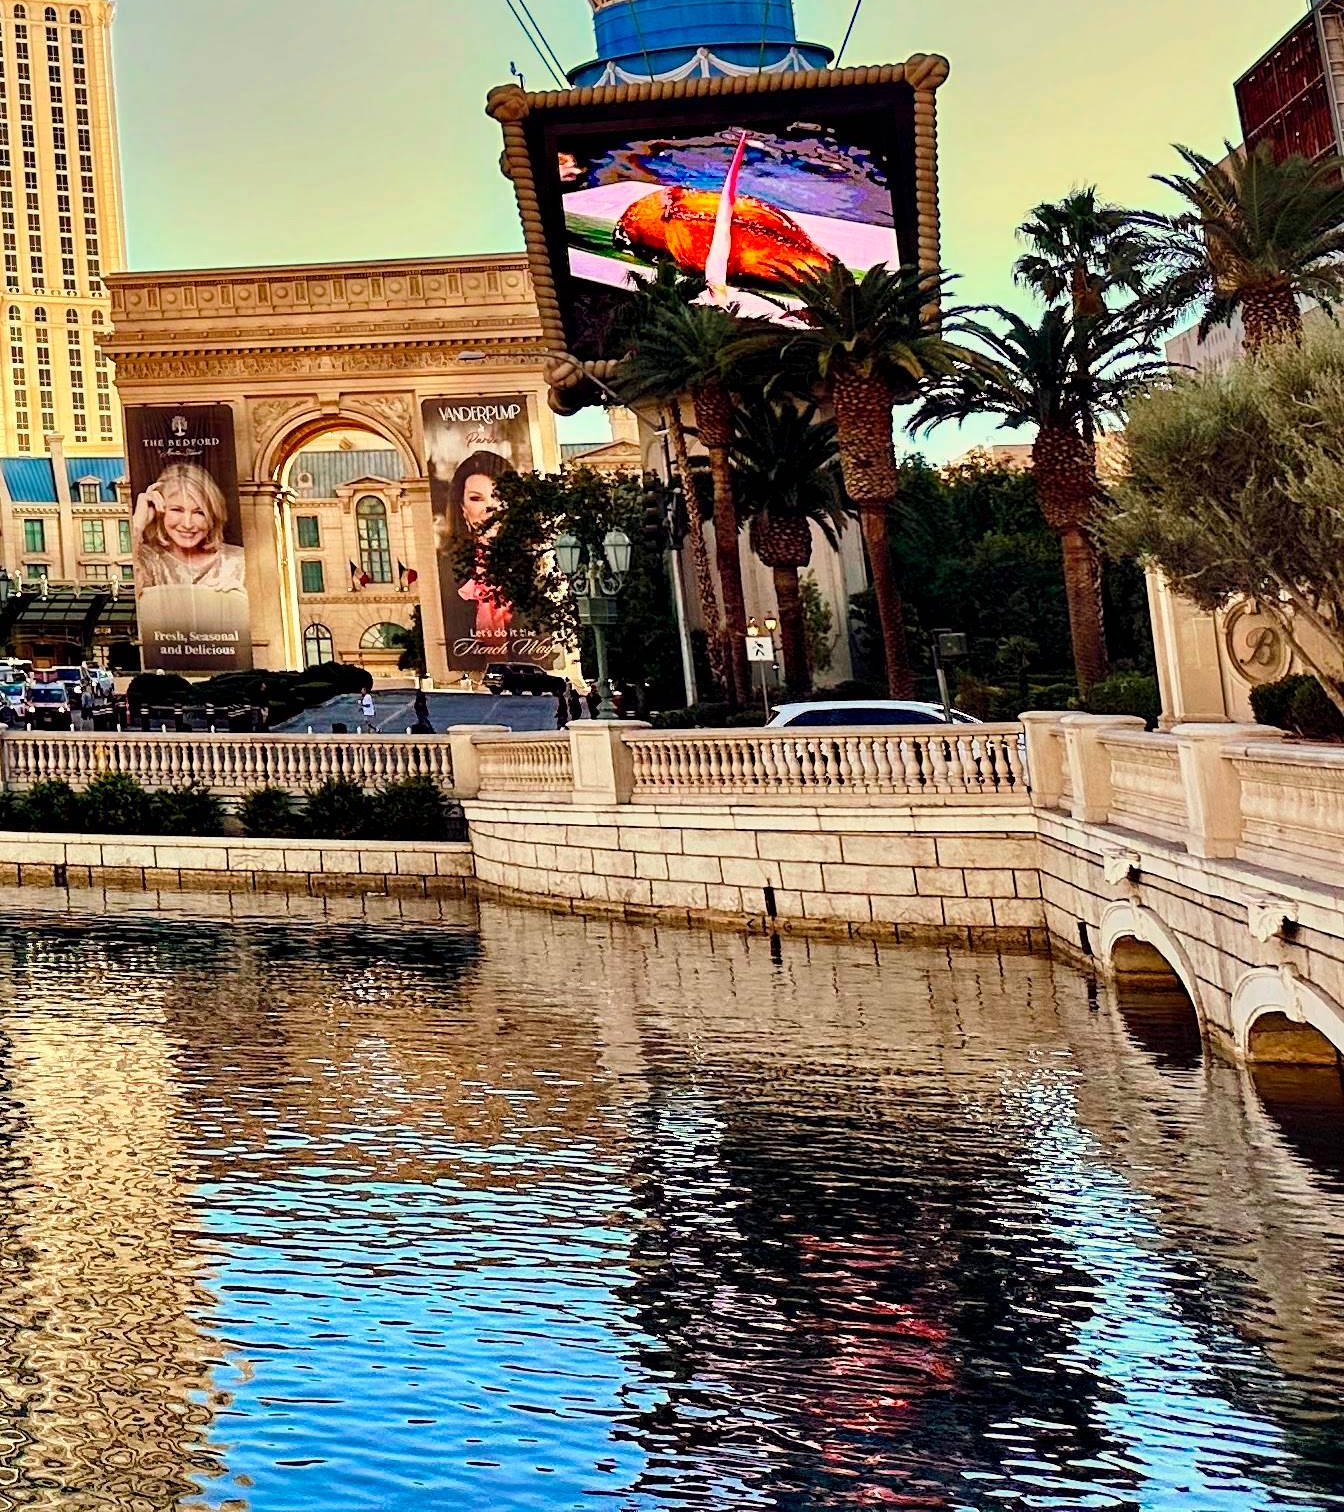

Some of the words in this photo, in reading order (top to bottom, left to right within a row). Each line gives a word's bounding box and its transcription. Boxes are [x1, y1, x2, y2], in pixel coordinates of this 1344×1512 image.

[438, 404, 521, 424] VANDERPUMP
[143, 439, 164, 447] THE
[168, 437, 220, 447] BEDFORD
[153, 630, 188, 643] Fresh,
[189, 630, 240, 642] Seasonal
[494, 628, 508, 637] do
[509, 628, 517, 637] it
[160, 644, 182, 655] and
[184, 644, 236, 655] Delicious
[453, 637, 511, 657] French
[512, 636, 553, 661] Way
